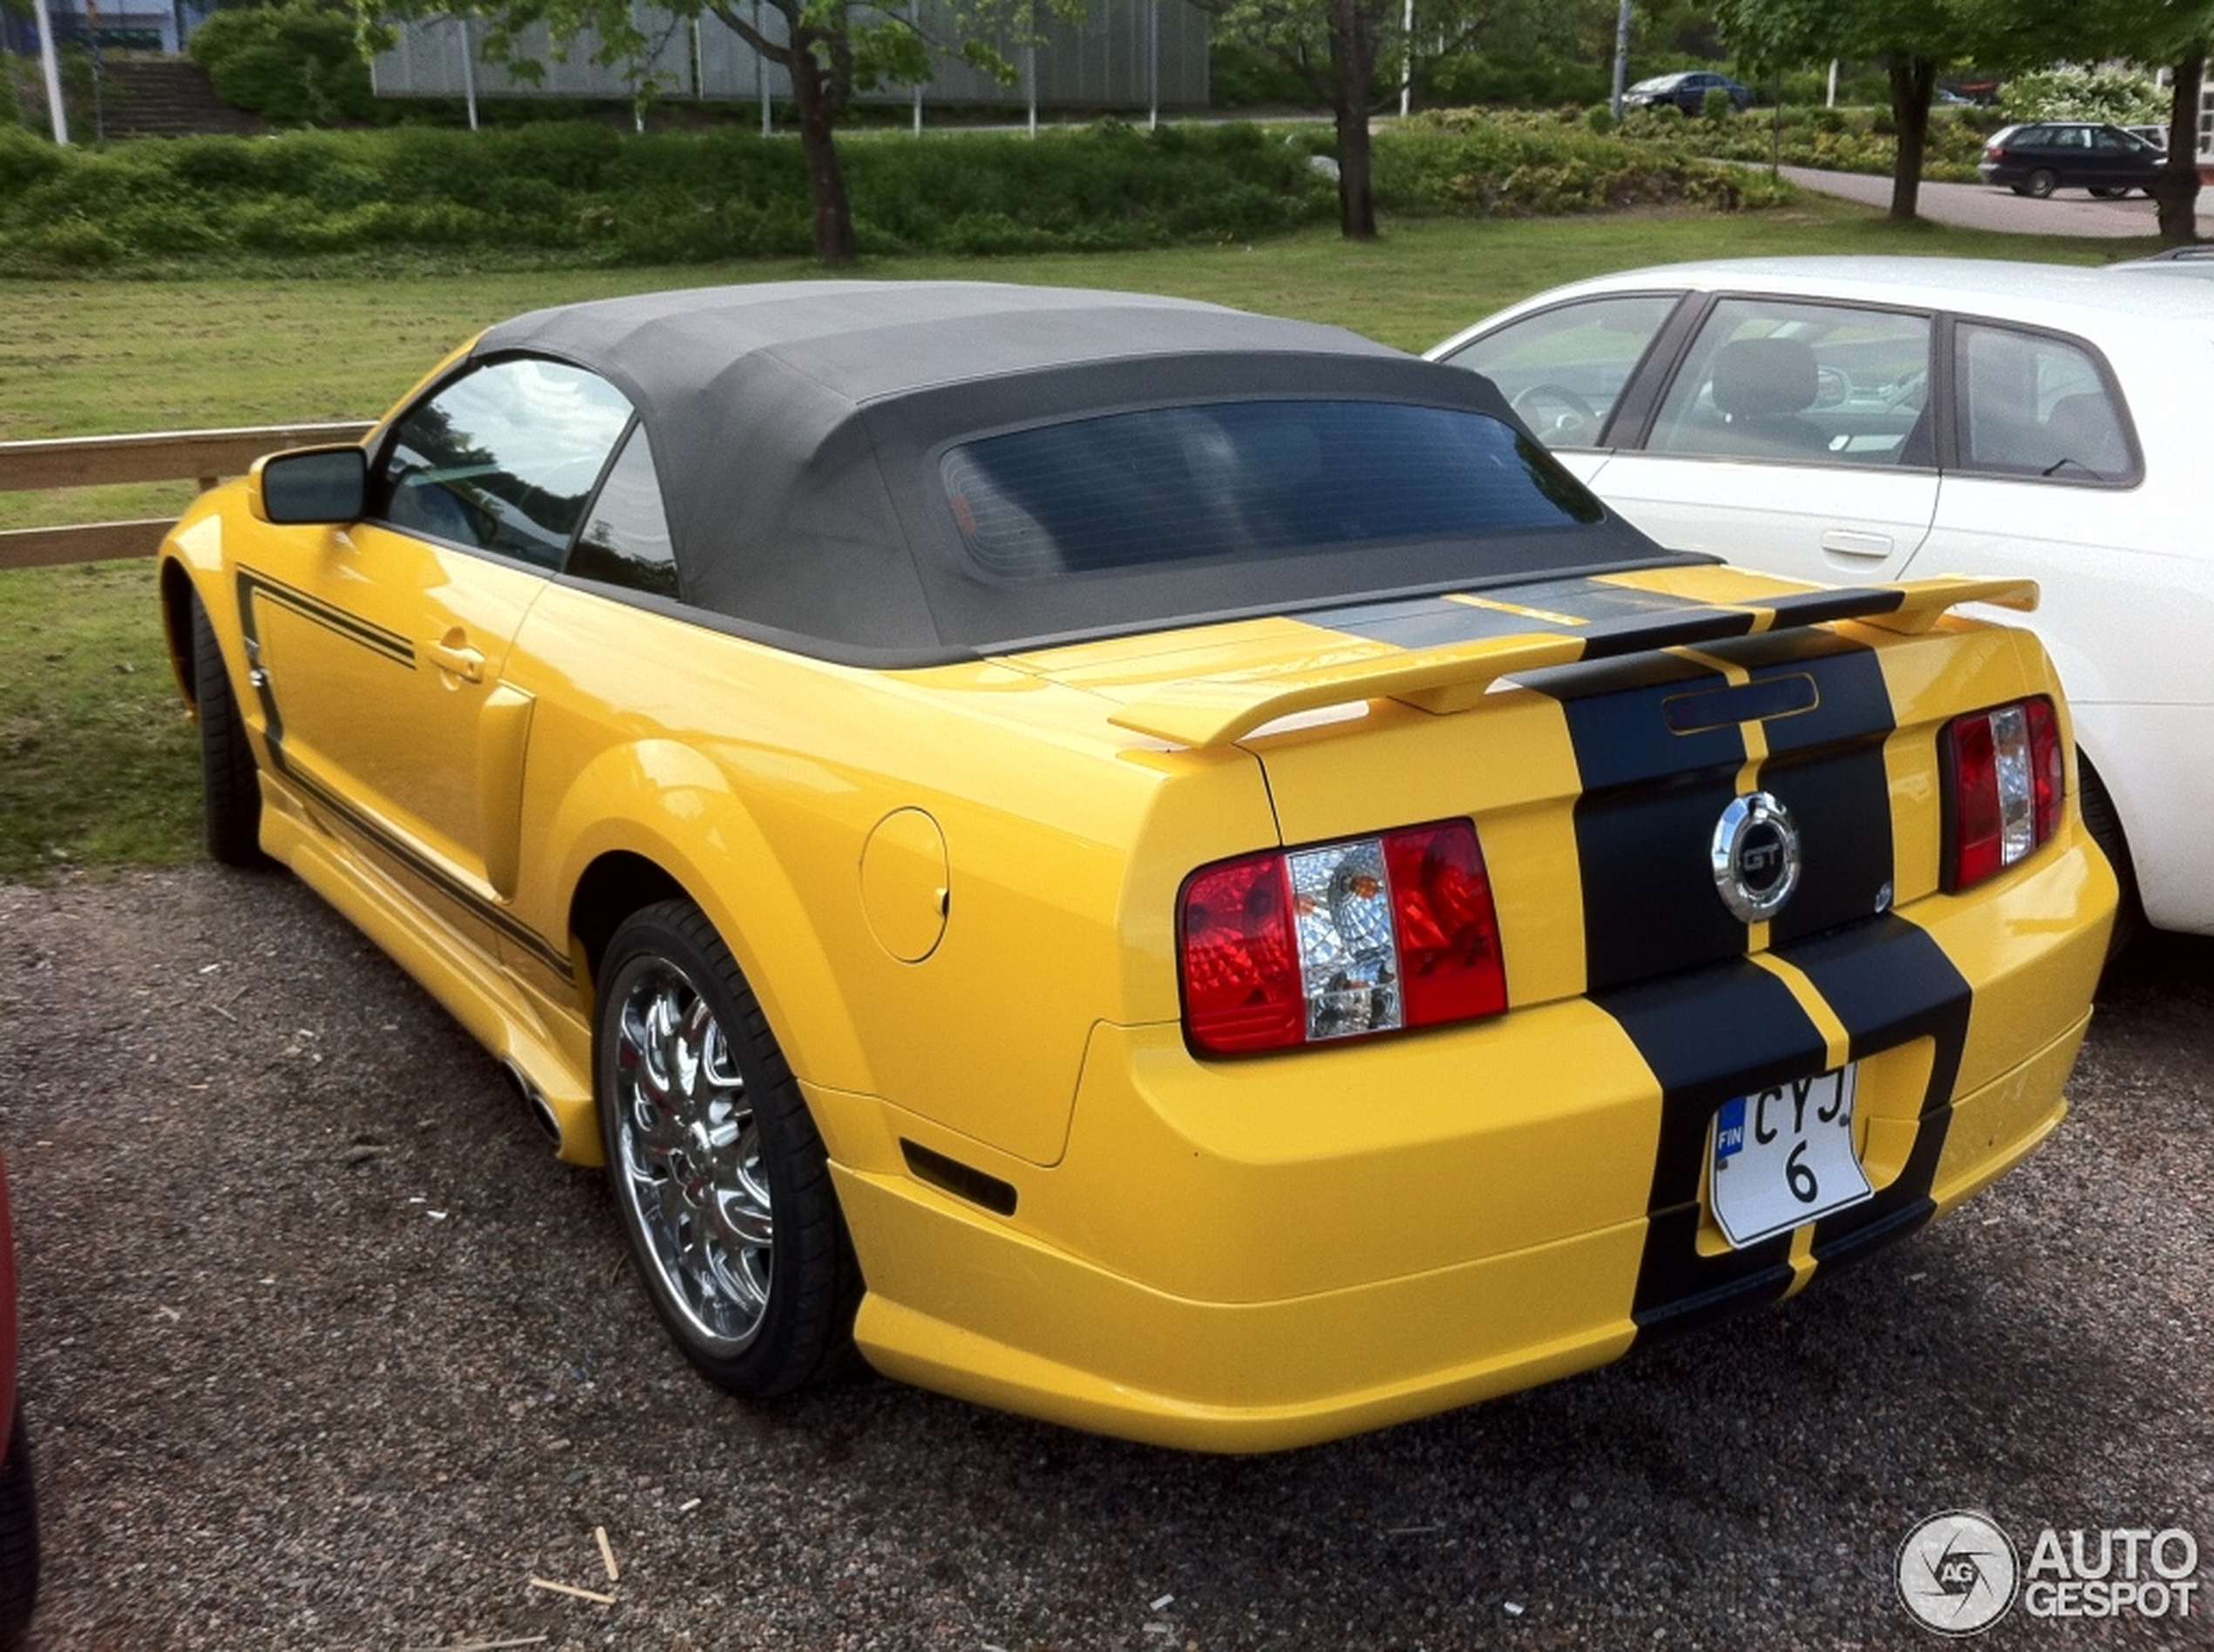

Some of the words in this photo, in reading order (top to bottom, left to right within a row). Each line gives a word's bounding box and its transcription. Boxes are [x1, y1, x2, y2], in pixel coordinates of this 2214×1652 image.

[1744, 842, 1780, 871] GT
[1755, 1071, 1844, 1145] CYJ
[1718, 1126, 1742, 1149] FIN
[1786, 1140, 1817, 1202] 6
